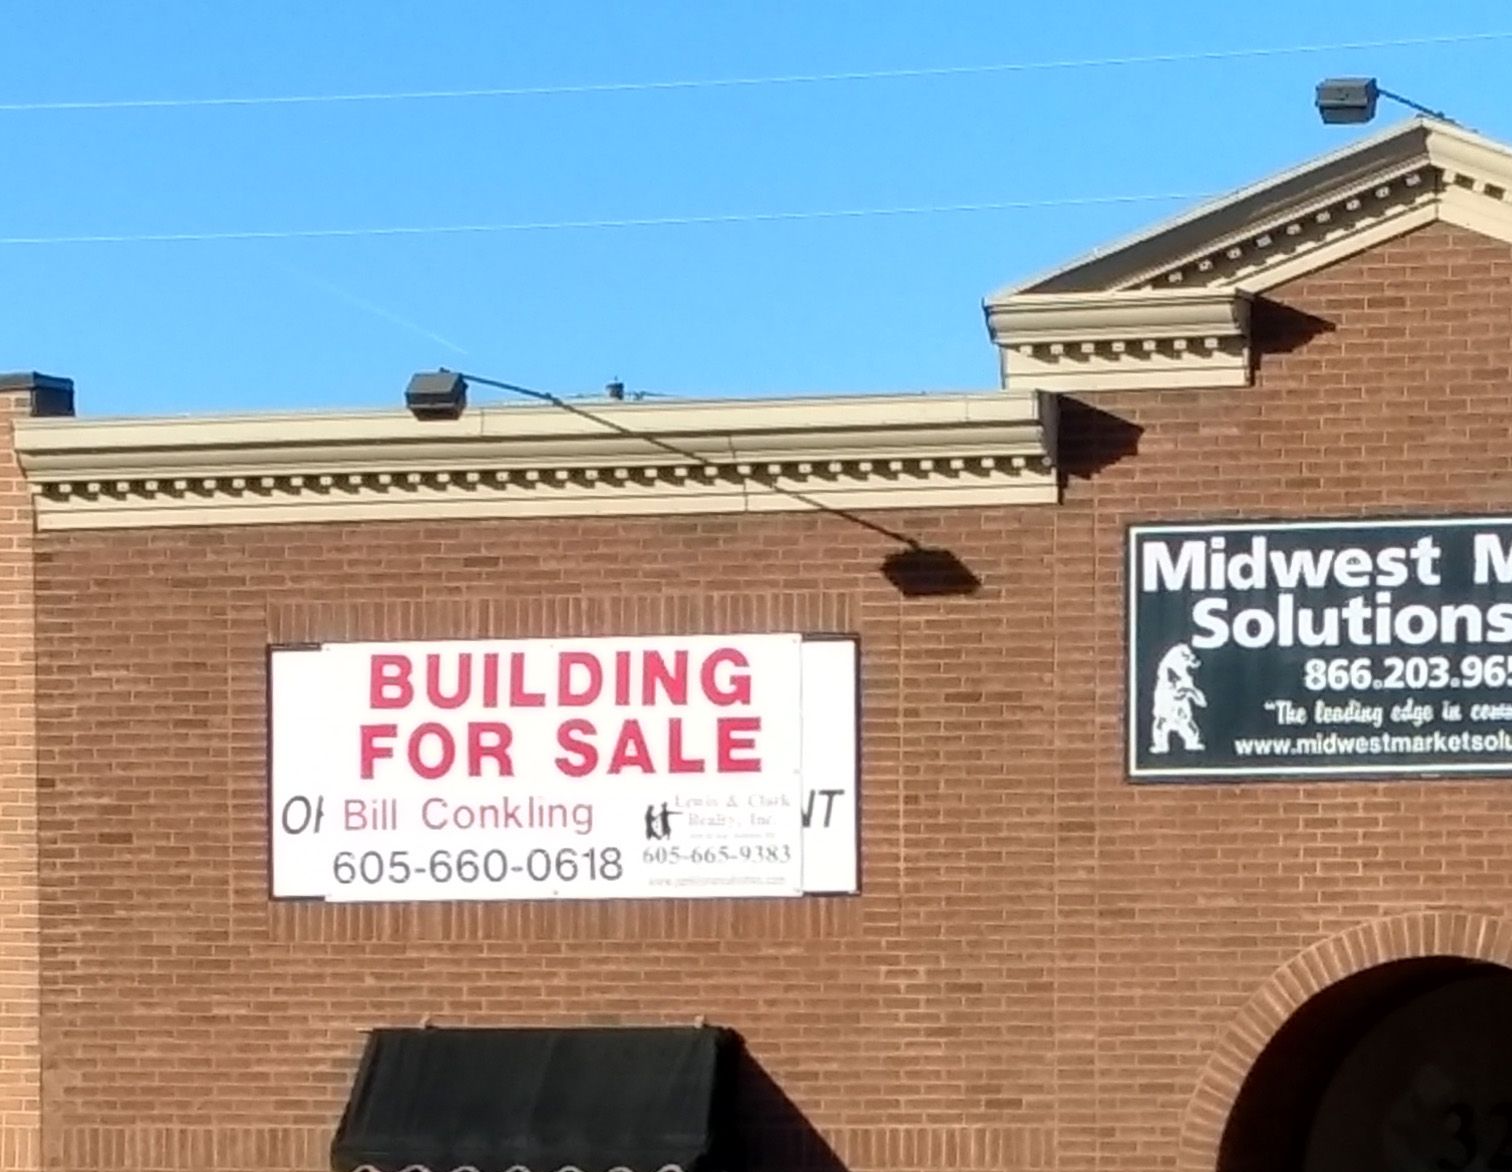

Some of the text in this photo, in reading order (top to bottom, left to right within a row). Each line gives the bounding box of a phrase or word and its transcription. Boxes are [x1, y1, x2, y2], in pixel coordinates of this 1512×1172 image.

[1142, 536, 1441, 592] Midwest
[370, 648, 752, 709] BUILDING
[1314, 699, 1384, 728] leading
[1390, 697, 1434, 727] edge
[1441, 700, 1463, 722] in
[359, 717, 762, 780] FOR SALE
[344, 796, 593, 836] Bill Conkling
[332, 846, 623, 885] 605-660-0618
[642, 844, 791, 865] 605-665-9383
